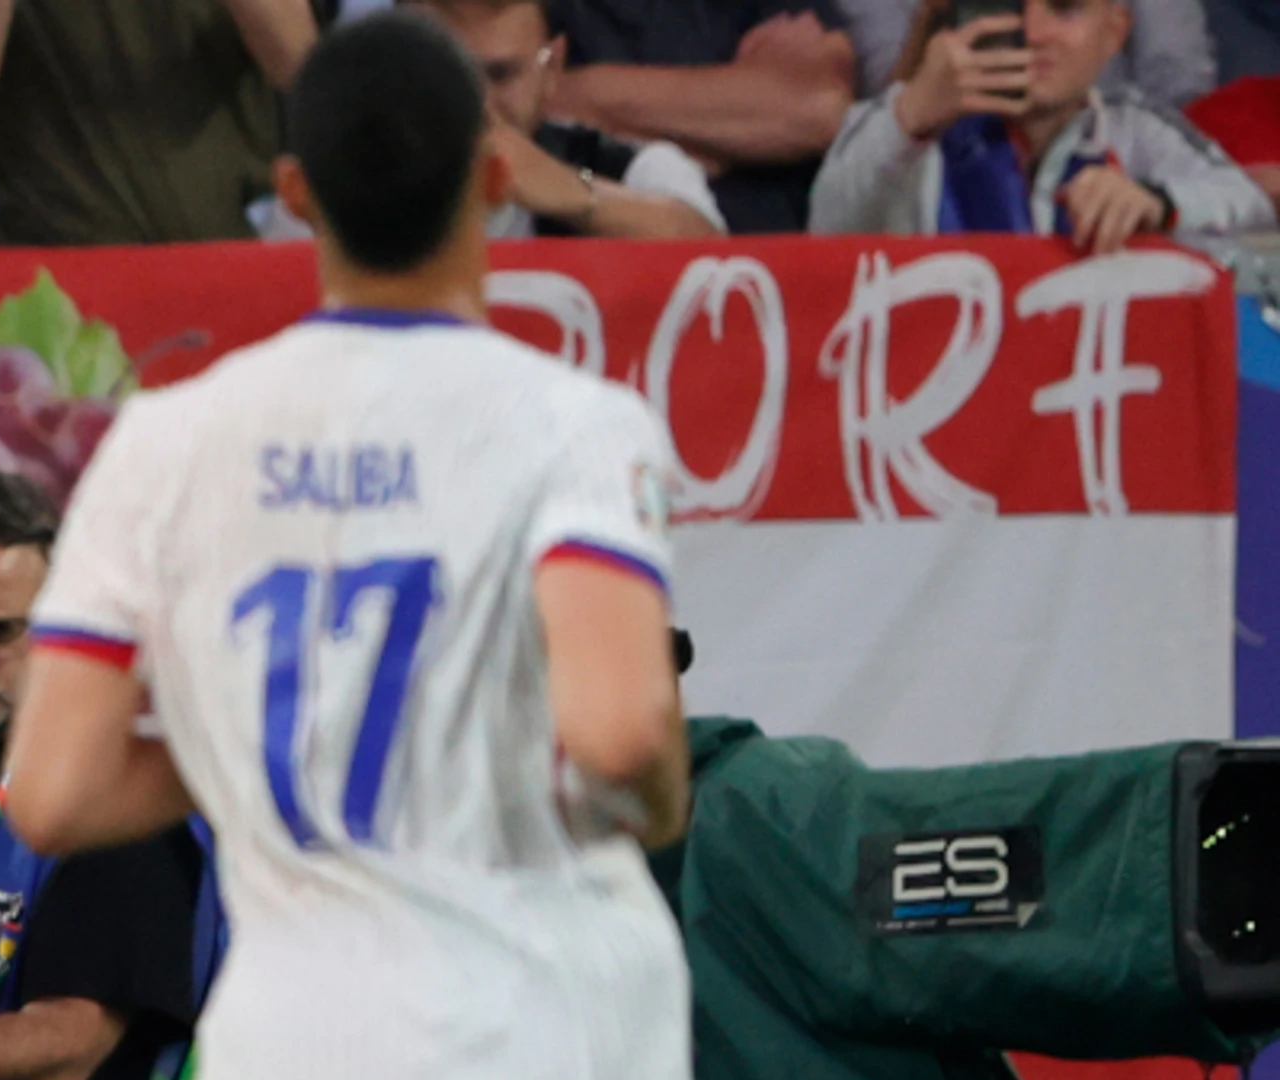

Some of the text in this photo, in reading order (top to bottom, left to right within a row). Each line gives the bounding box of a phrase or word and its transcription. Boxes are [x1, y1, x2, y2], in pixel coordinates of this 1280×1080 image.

[257, 442, 418, 512] SALIBA
[230, 555, 441, 852] 17
[893, 836, 1009, 901] ES
